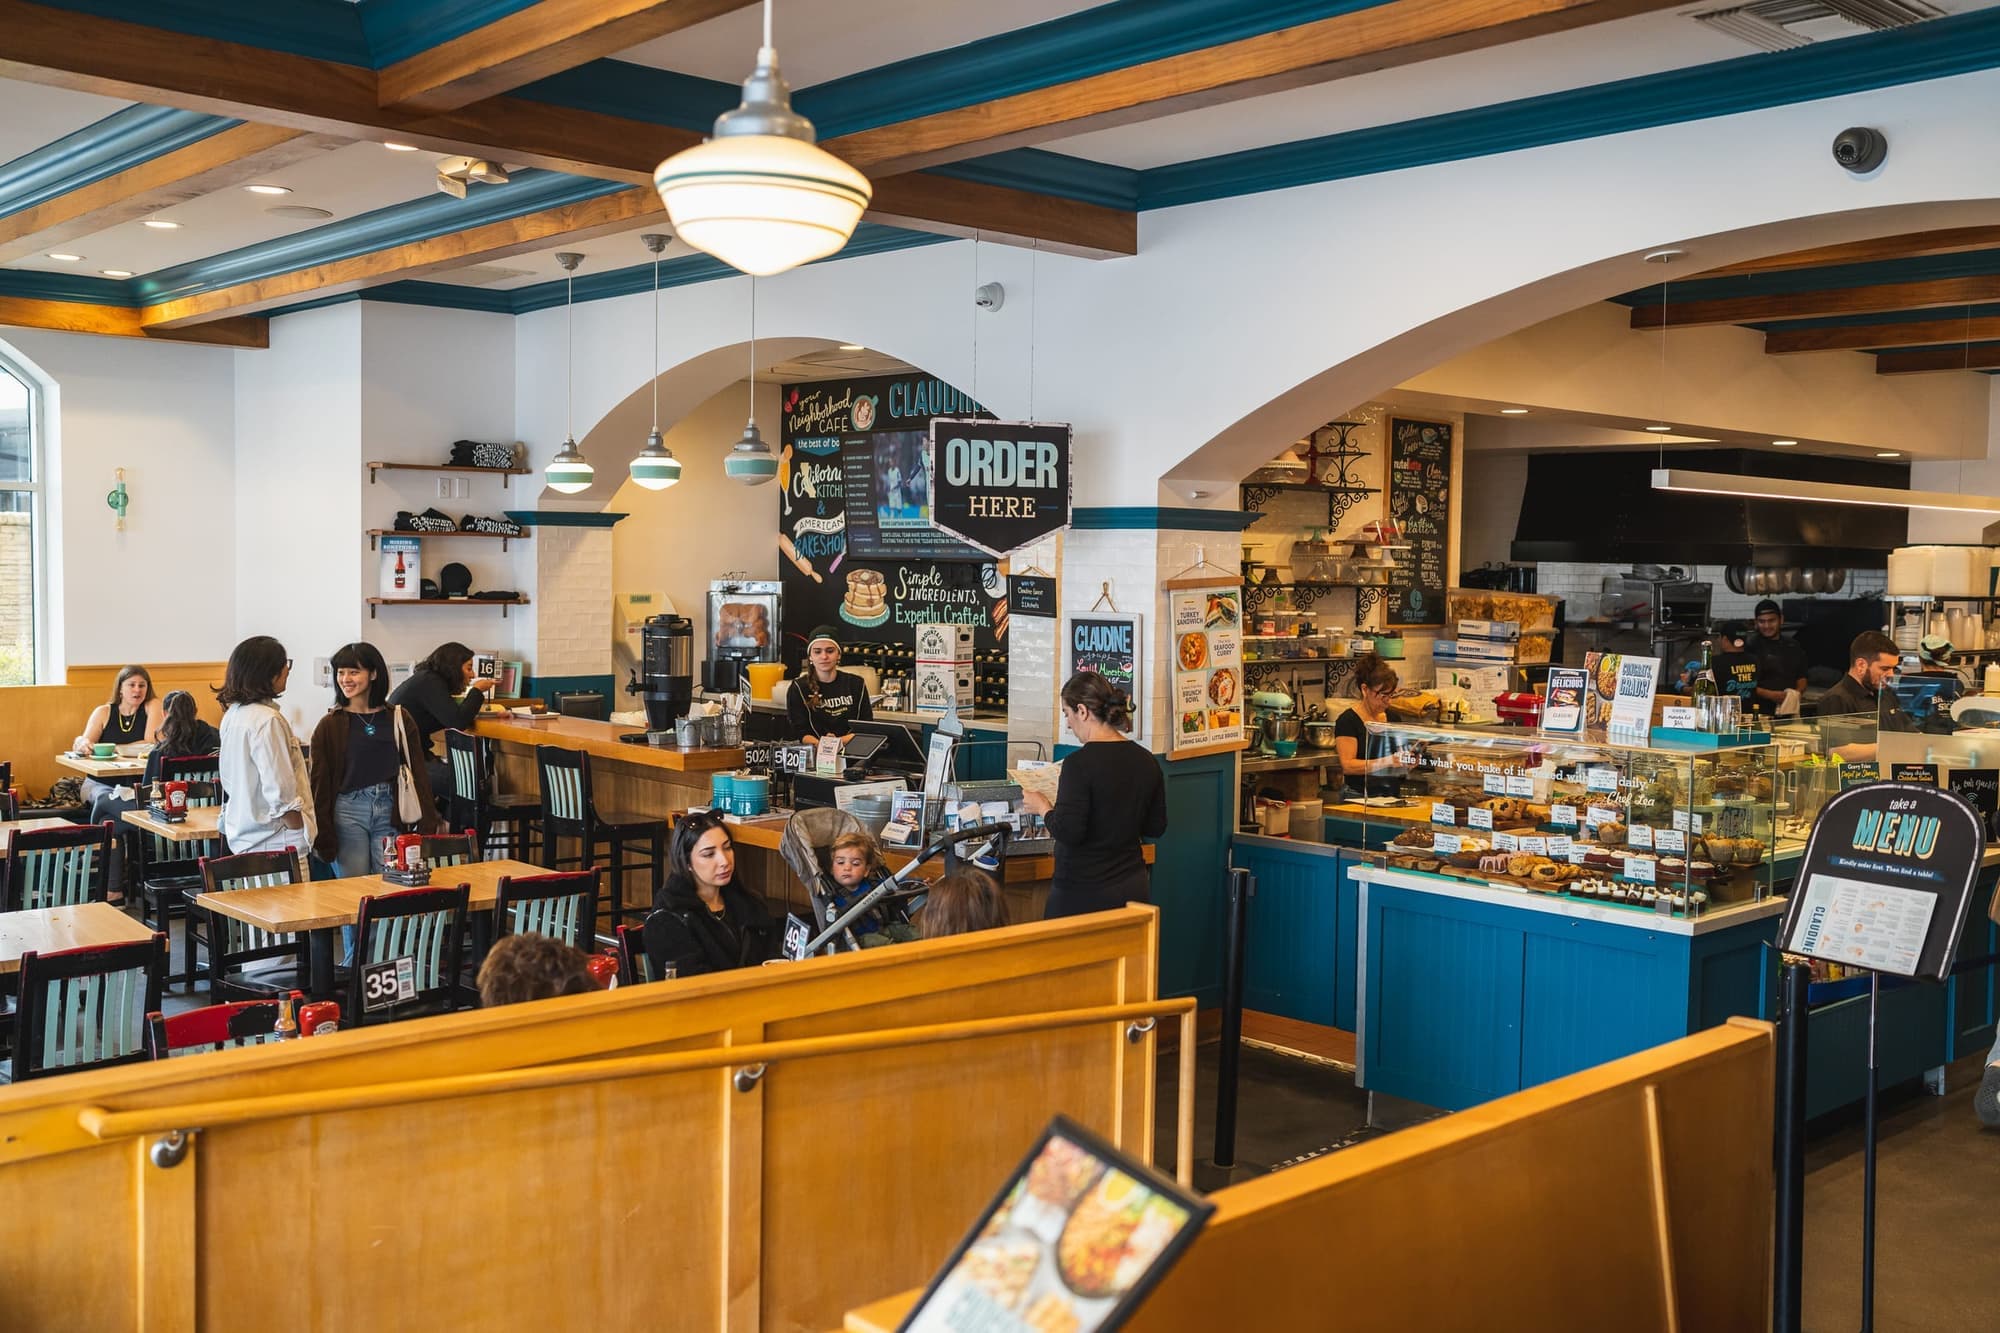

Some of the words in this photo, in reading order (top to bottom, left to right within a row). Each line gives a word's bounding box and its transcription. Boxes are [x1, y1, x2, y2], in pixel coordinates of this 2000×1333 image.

[799, 390, 821, 412] your
[889, 380, 989, 418] CLAUDI
[789, 387, 853, 433] Neighborhood
[819, 416, 849, 433] CAFÉ
[798, 440, 808, 449] the
[809, 440, 821, 448] best
[823, 438, 831, 447] of
[832, 439, 840, 447] bo
[945, 438, 1059, 489] ORDER
[793, 463, 842, 498] Californ
[816, 483, 844, 498] KITCH
[816, 500, 826, 515] &
[968, 496, 1036, 519] HERE
[800, 517, 844, 530] AMERICAN
[894, 565, 943, 600] Simple
[909, 587, 981, 606] INGREDIENTS,
[895, 603, 936, 628] Expertly
[943, 604, 992, 628] Crafted.
[1176, 617, 1204, 626] SANDWICH
[1180, 611, 1200, 619] TURKEY
[921, 630, 943, 642] MOUNTAIN
[1074, 625, 1132, 654] CLAUDINE
[1213, 643, 1236, 651] SEAFOOD
[1216, 649, 1232, 657] CURRY
[480, 663, 494, 675] 16
[1730, 664, 1757, 675] LIVING
[921, 675, 944, 689] MOUNTAIN
[1552, 677, 1584, 689] DELICIOUS
[1737, 673, 1753, 682] THE
[1182, 689, 1202, 698] BRUNCH
[1619, 676, 1651, 699] GRADS!
[924, 693, 942, 701] VALLEY
[1185, 696, 1200, 704] BOWL
[745, 750, 759, 765] 50
[759, 749, 770, 763] 24
[775, 750, 784, 764] 5
[787, 752, 799, 767] 20
[1430, 757, 1453, 769] what
[1456, 762, 1474, 773] you
[1477, 760, 1501, 775] bake
[1504, 765, 1514, 776] of
[895, 799, 922, 809] DELICIOUS
[1635, 793, 1656, 807] Lea
[1889, 798, 1910, 810] take
[1909, 799, 1917, 809] a
[1852, 808, 1942, 860] MENU
[1839, 857, 1857, 869] Kindly
[1857, 861, 1872, 870] order
[1885, 864, 1900, 874] Then
[1900, 866, 1913, 876] find
[1917, 870, 1934, 879] table!
[1802, 905, 1826, 954] CLAUDINE
[786, 926, 800, 951] 49
[366, 969, 398, 998] 35
